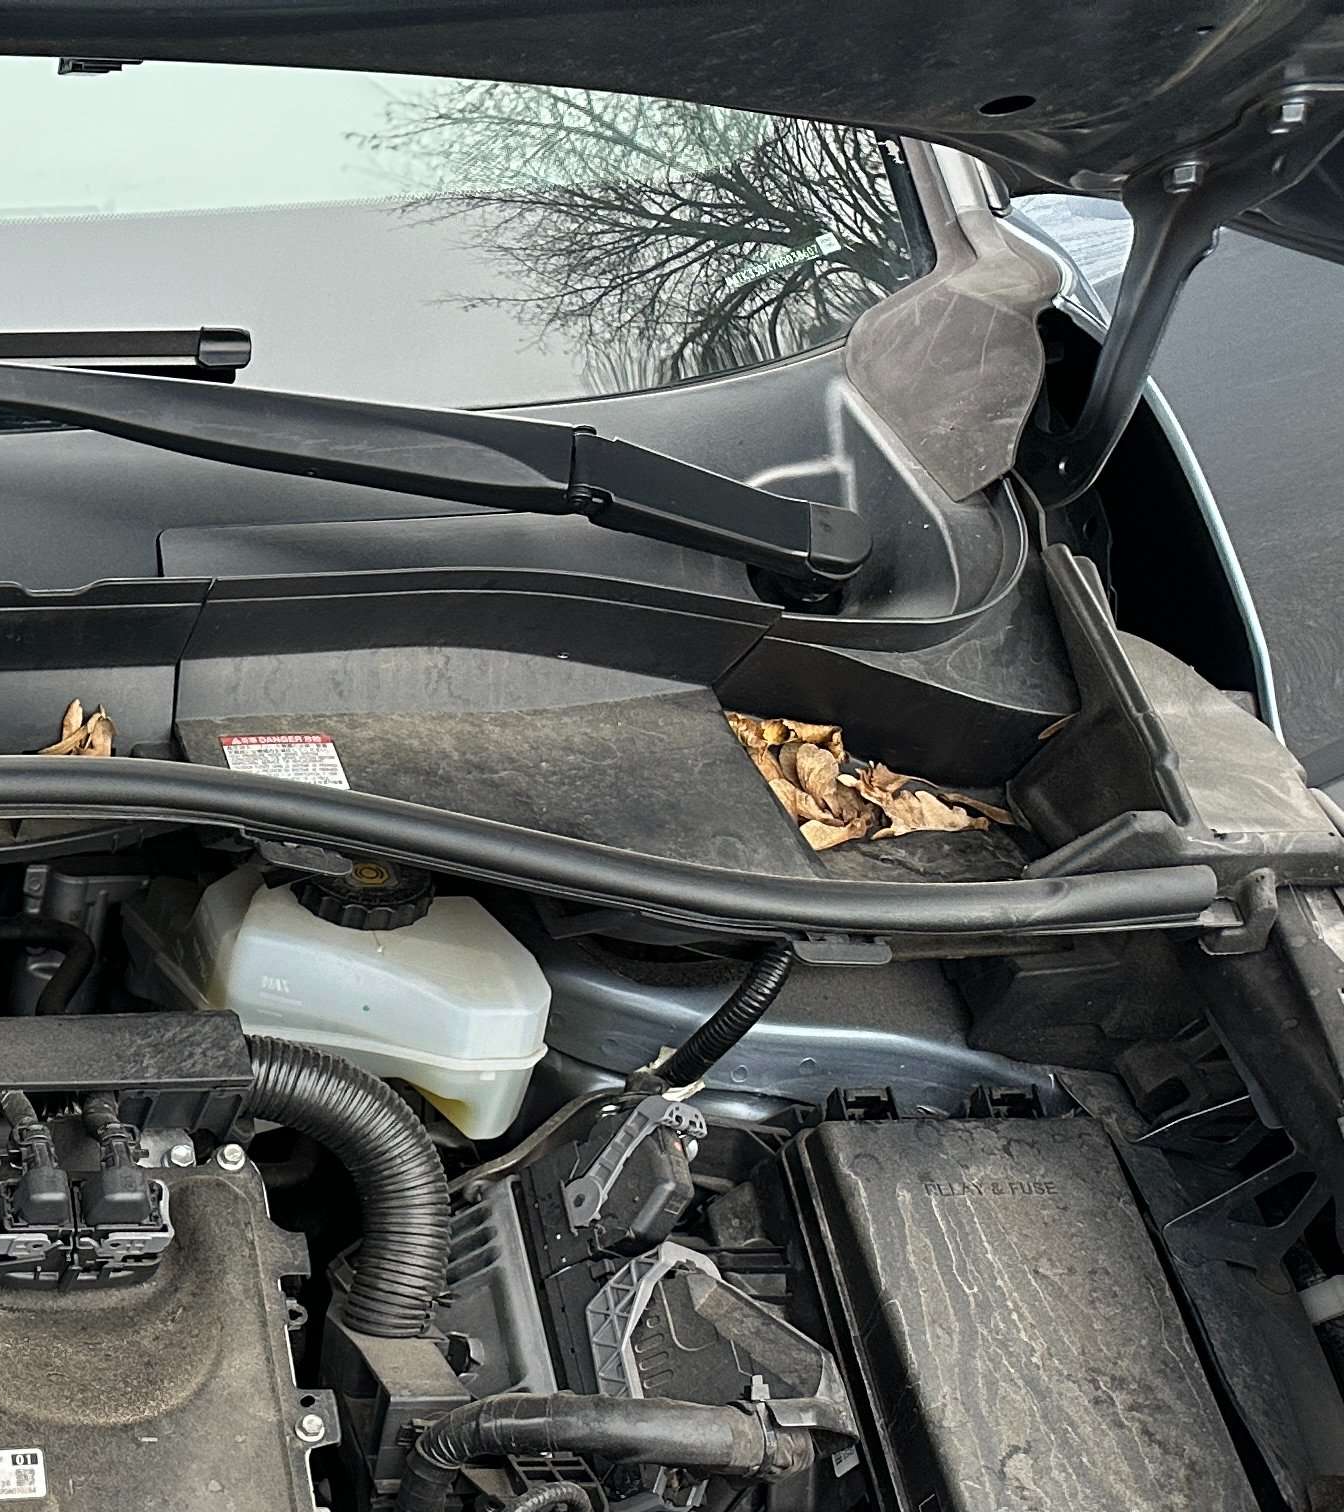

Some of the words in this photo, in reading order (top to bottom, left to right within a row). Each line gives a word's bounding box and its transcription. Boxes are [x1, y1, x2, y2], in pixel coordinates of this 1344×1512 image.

[258, 734, 303, 744] DANGER
[924, 1182, 983, 1197] RELAY
[991, 1181, 1005, 1196] &
[1008, 1180, 1058, 1196] FUSE
[15, 1454, 33, 1466] 01
